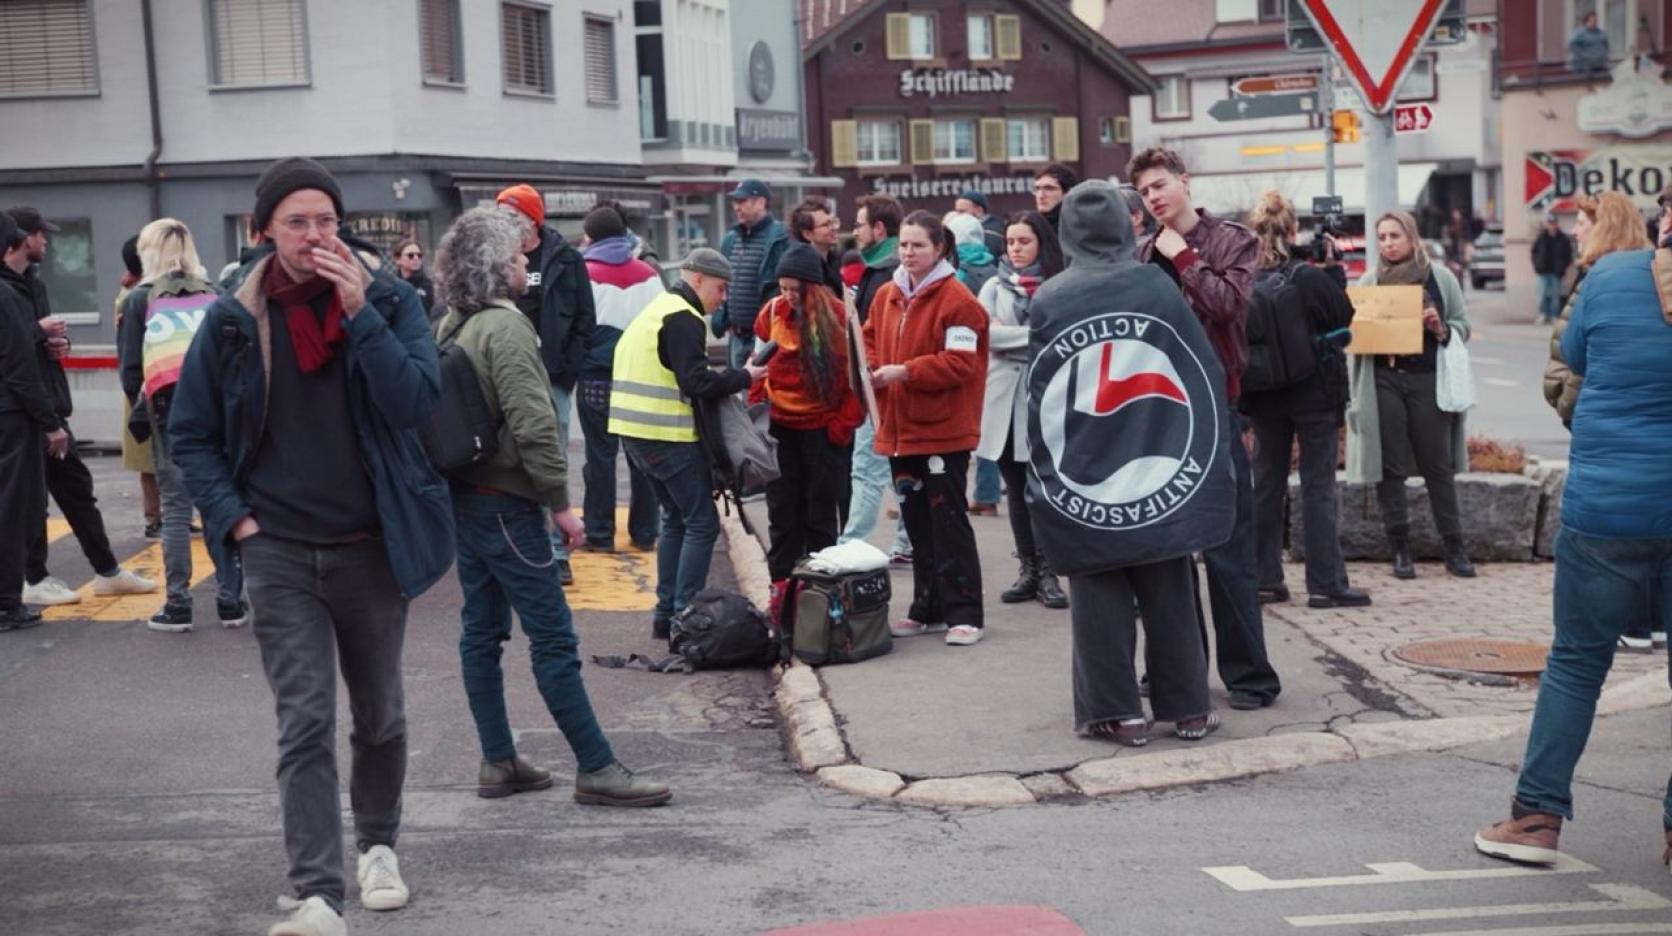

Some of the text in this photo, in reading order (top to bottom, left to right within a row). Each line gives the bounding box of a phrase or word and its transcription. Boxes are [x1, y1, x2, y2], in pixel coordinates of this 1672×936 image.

[900, 68, 1015, 98] Schifflände
[873, 176, 1035, 200] Speiserestauran
[1553, 158, 1672, 198] Deko
[1054, 317, 1151, 359] ACTION
[1051, 455, 1203, 525] ANTIFASCIST
